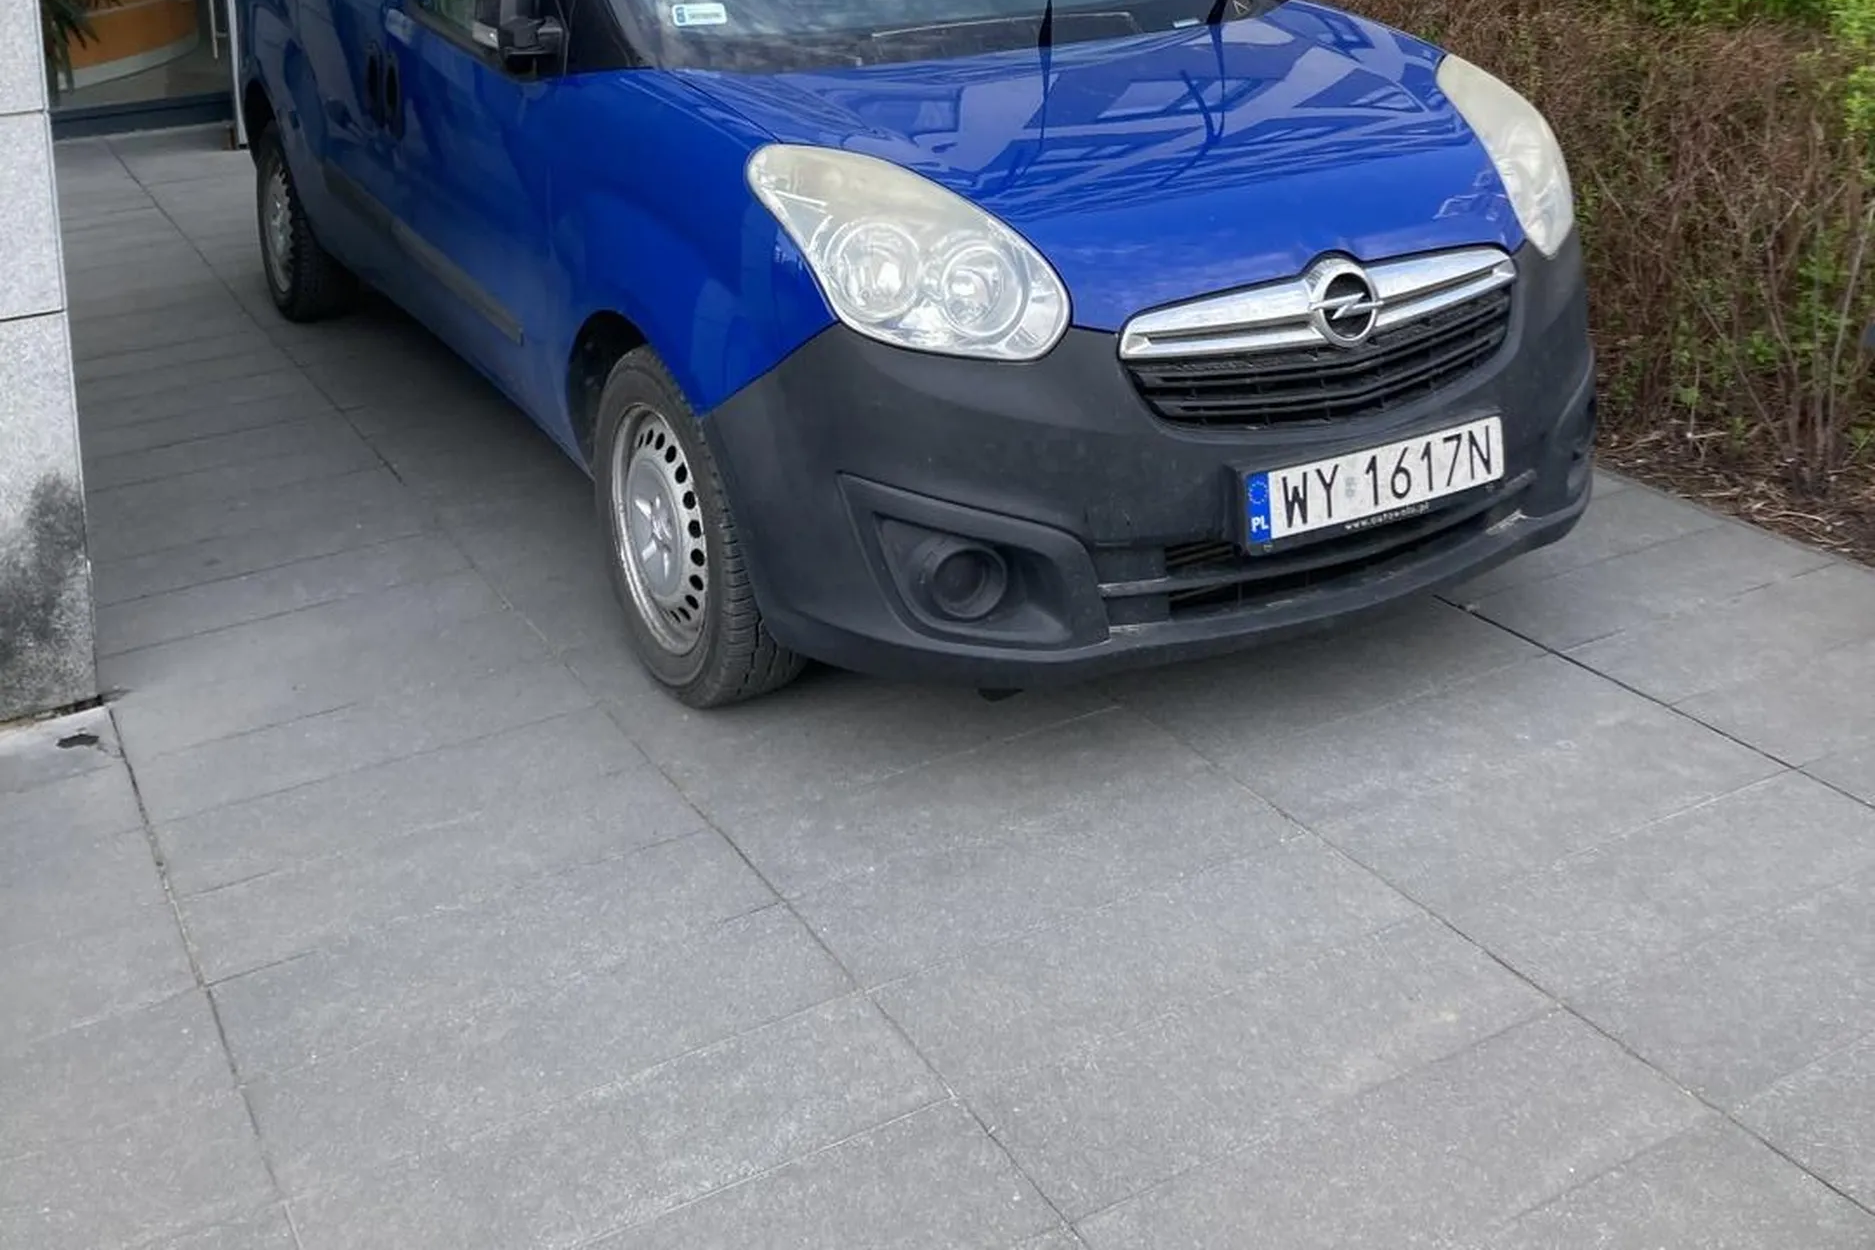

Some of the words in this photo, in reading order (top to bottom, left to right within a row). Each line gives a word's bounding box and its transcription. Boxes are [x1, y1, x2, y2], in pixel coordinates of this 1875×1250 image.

[1281, 463, 1339, 528] WY
[1365, 425, 1492, 507] 1617N
[1251, 518, 1269, 533] PL
